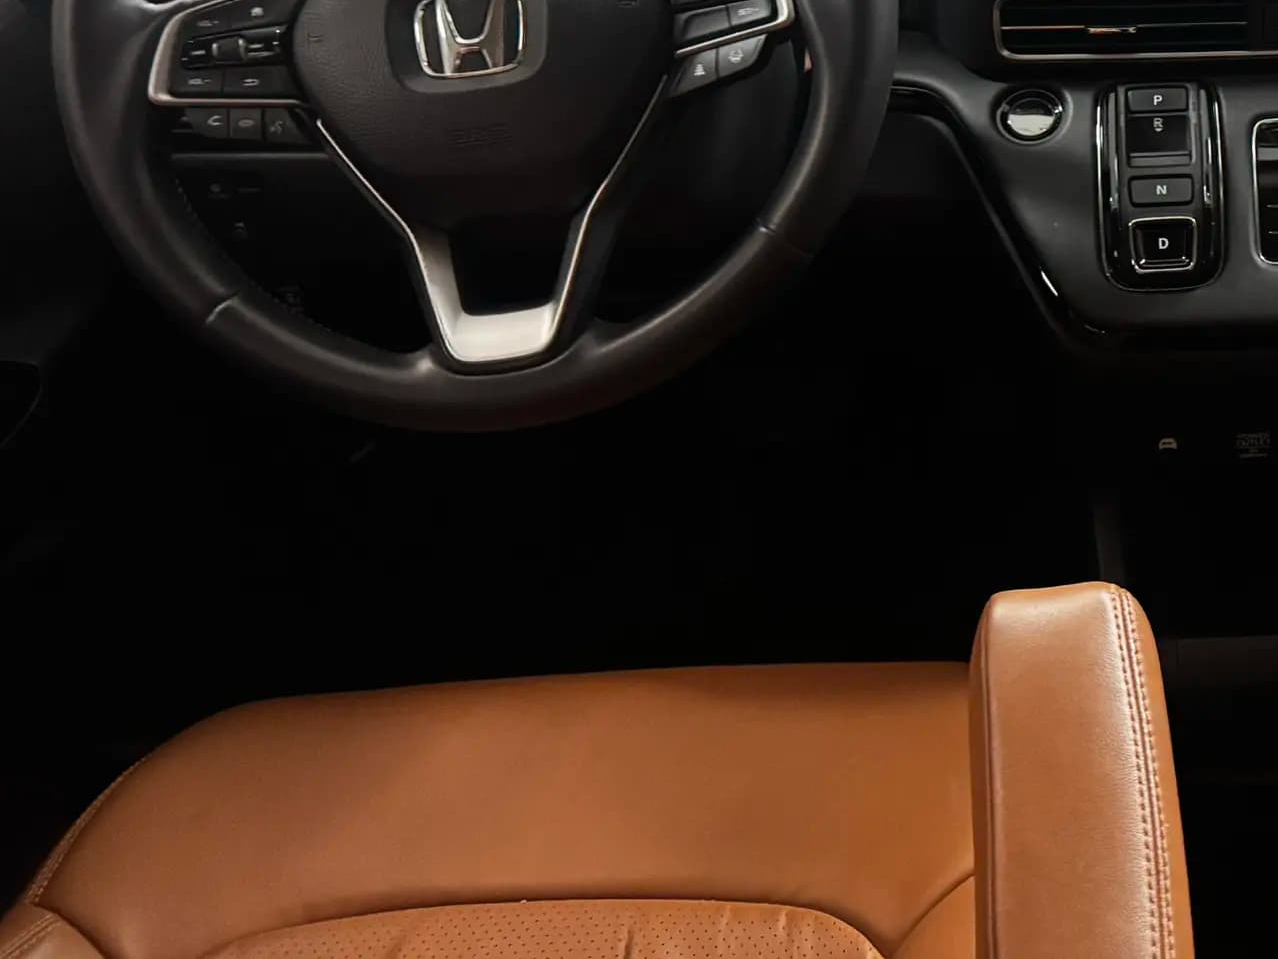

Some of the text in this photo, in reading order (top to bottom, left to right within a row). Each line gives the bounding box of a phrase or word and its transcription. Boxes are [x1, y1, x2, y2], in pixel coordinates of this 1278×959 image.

[1153, 94, 1163, 106] P
[1153, 117, 1164, 128] R
[1156, 184, 1168, 196] N
[1158, 237, 1170, 250] D
